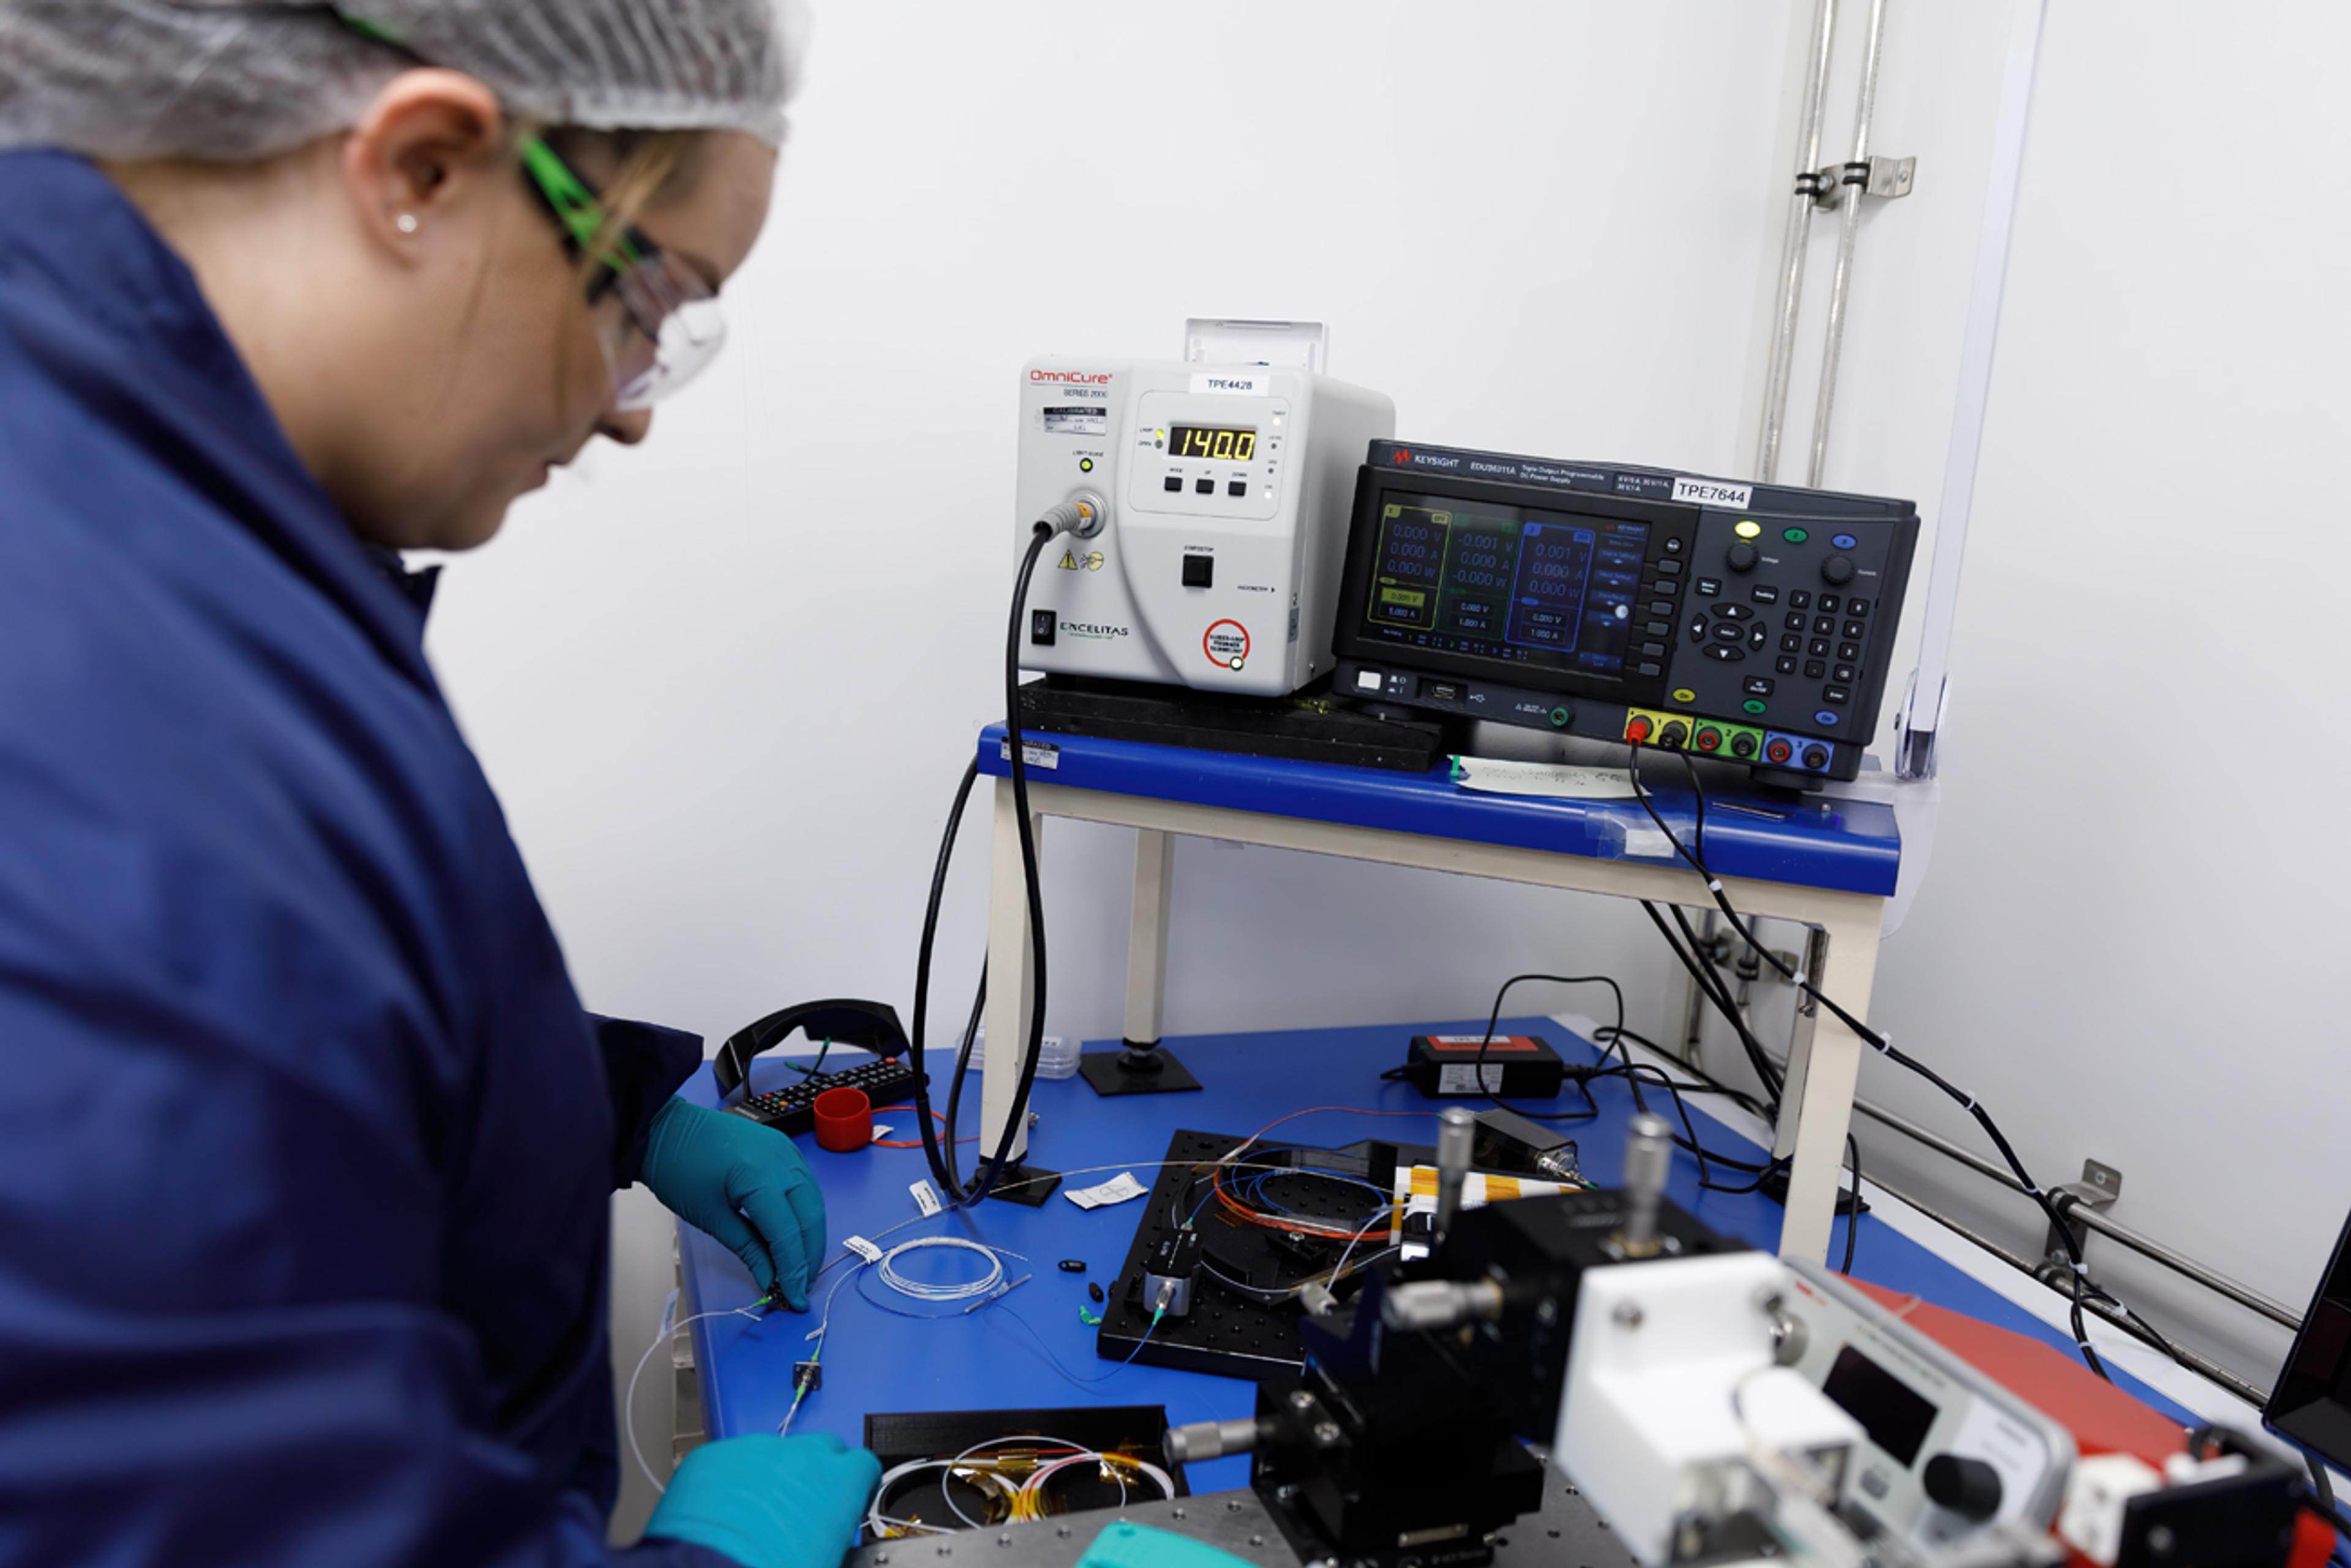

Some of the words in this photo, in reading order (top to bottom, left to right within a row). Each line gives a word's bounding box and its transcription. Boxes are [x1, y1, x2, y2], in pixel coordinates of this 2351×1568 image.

[1208, 379, 1253, 390] TPE4428
[1181, 429, 1256, 460] 140.0
[1414, 454, 1460, 468] KEYSIGHT
[1679, 482, 1745, 503] TPE7644
[1393, 524, 1428, 540] 0.000
[1390, 542, 1425, 558] 0.000
[1535, 541, 1571, 560] 0.001
[1387, 558, 1422, 576] 0.000
[1460, 552, 1496, 568] 0.000
[1532, 561, 1569, 578] 0.000
[1529, 579, 1566, 596] 0.000
[1059, 621, 1129, 636] EXCELITAS
[1725, 729, 1732, 737] 2
